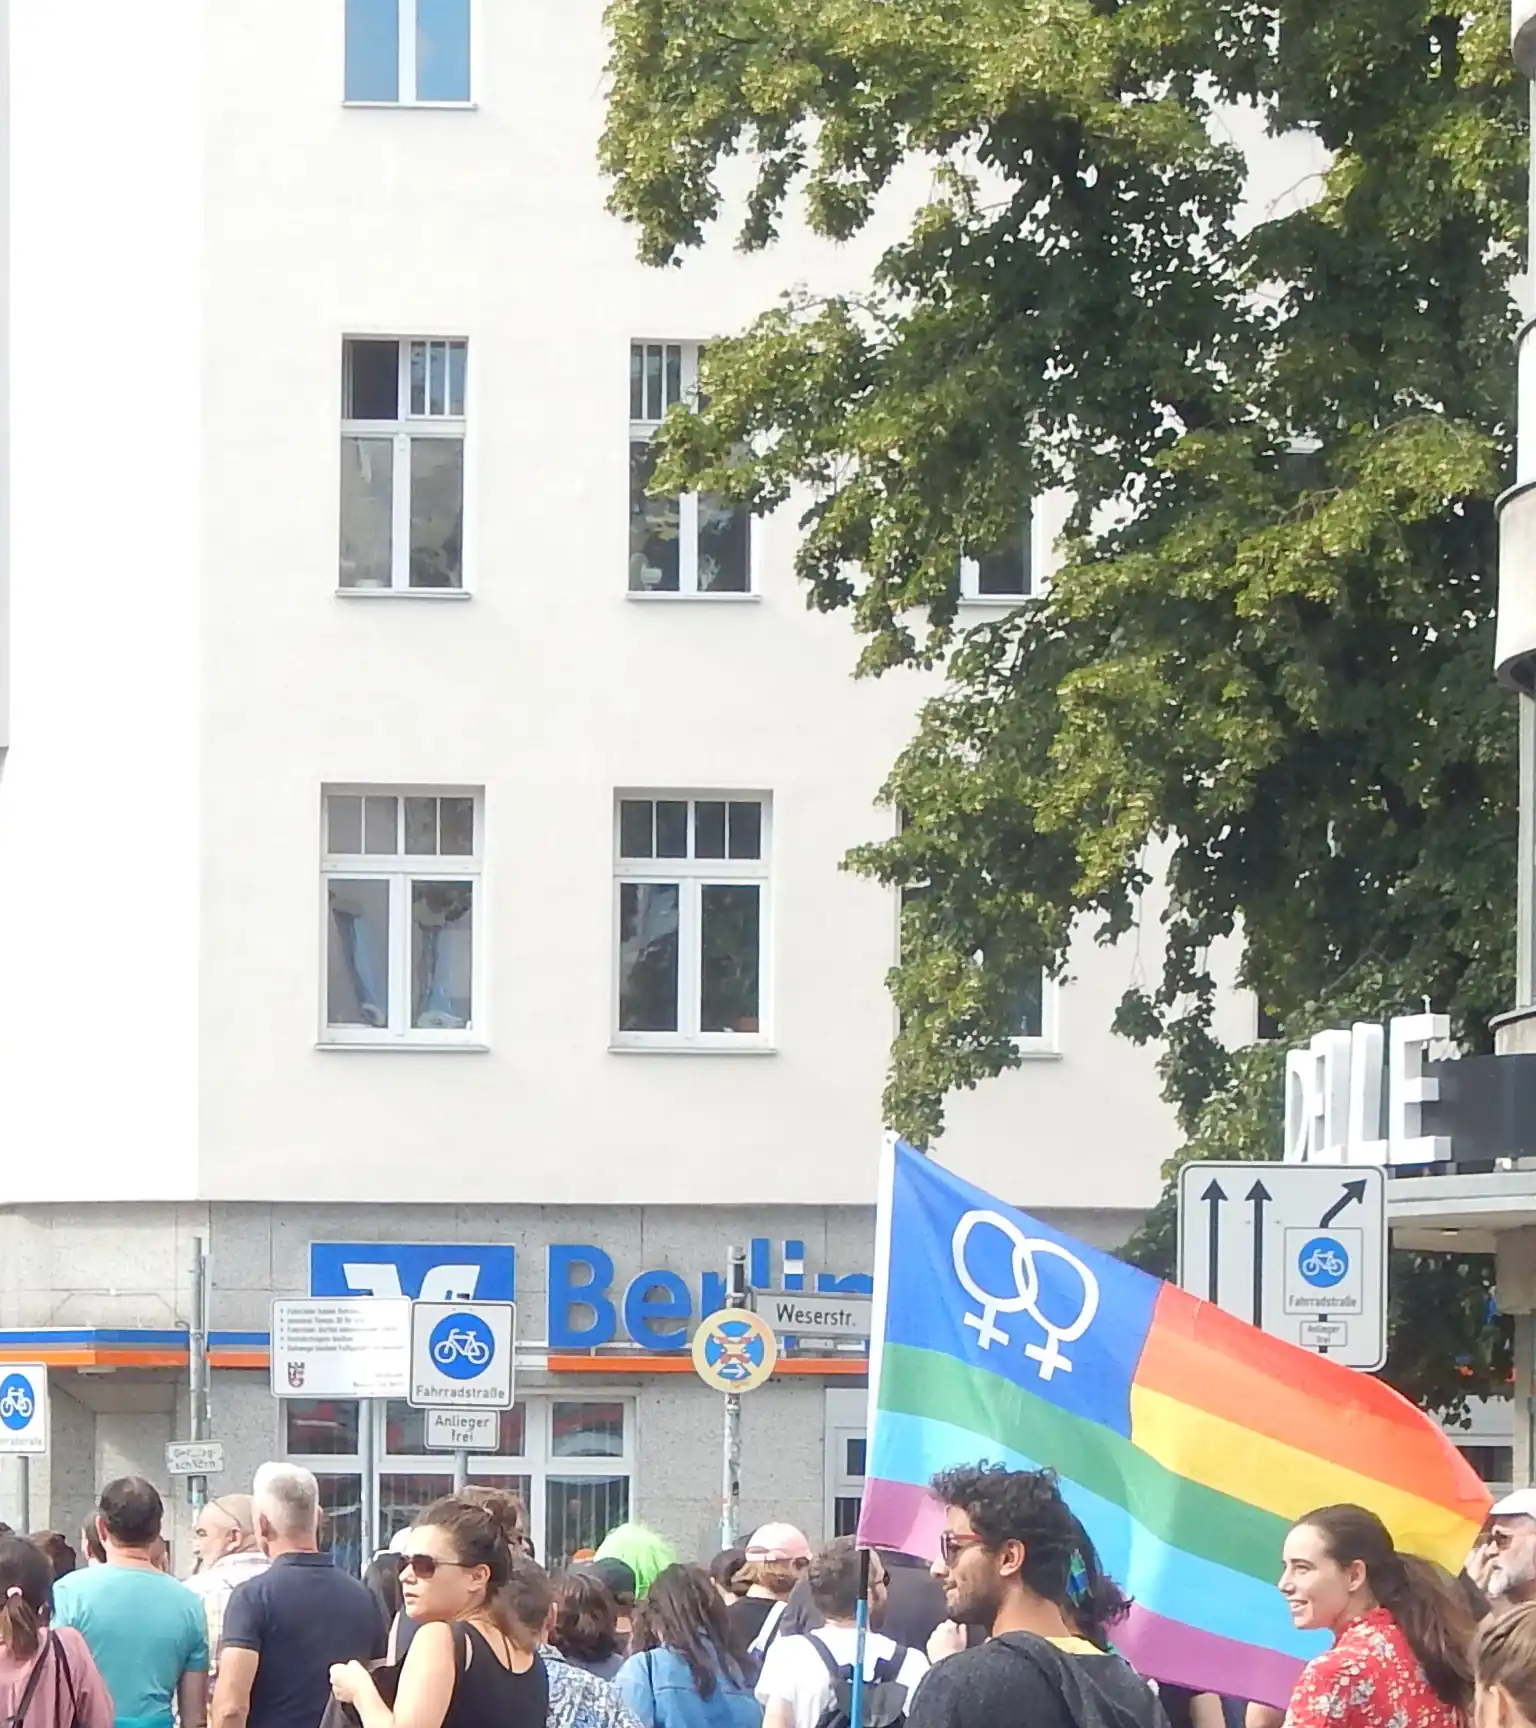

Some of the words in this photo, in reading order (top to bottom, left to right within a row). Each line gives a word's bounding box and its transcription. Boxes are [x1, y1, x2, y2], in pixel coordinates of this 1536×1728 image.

[776, 1302, 857, 1327] Weserstr.
[416, 1385, 506, 1400] Fahrradstraße
[434, 1414, 491, 1431] Anlieger
[451, 1428, 474, 1444] frei
